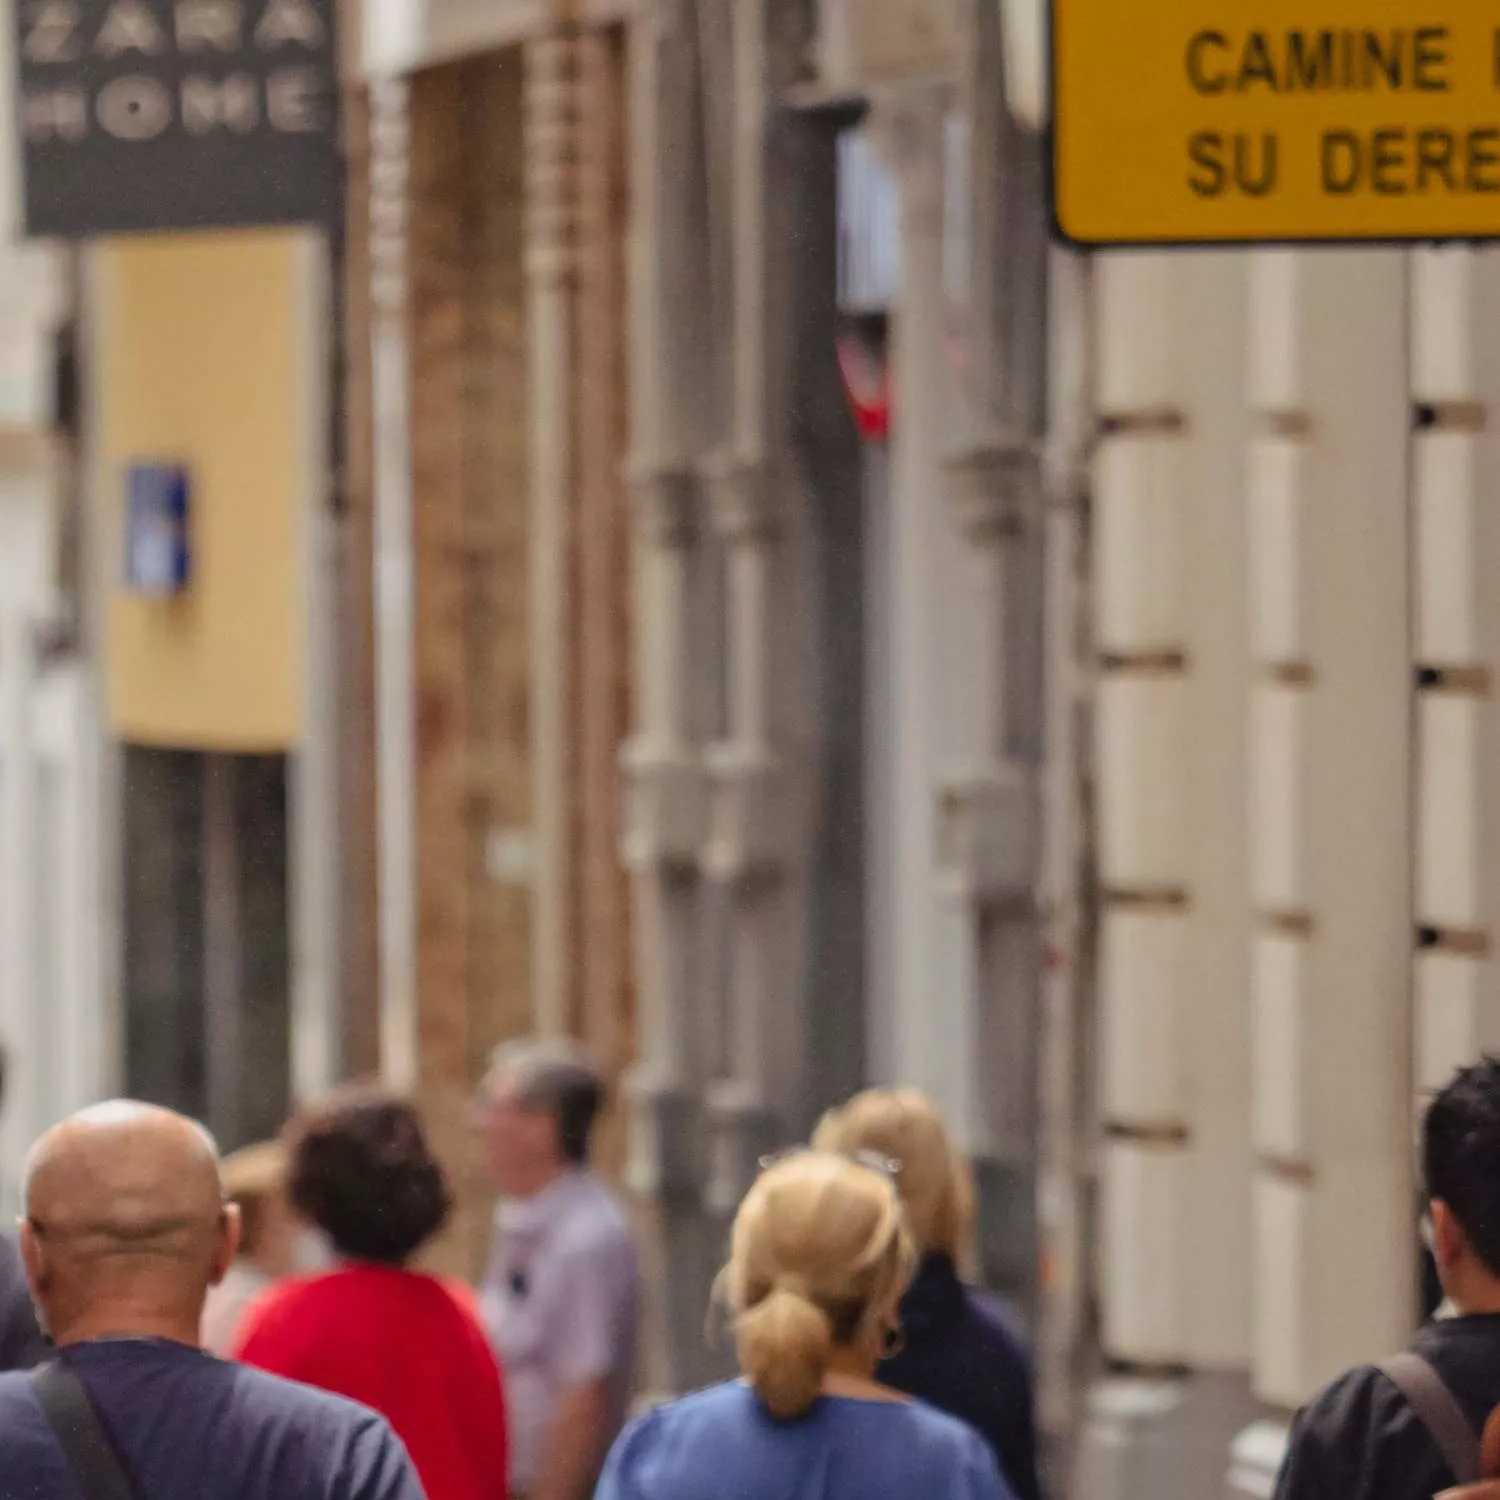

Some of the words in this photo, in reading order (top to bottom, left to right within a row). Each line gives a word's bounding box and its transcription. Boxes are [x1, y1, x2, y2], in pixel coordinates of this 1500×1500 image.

[22, 0, 326, 63] ZARA
[1184, 26, 1450, 95] CAMINE
[20, 68, 336, 143] HOME
[1186, 130, 1280, 197] SU
[1320, 126, 1500, 194] DERE
